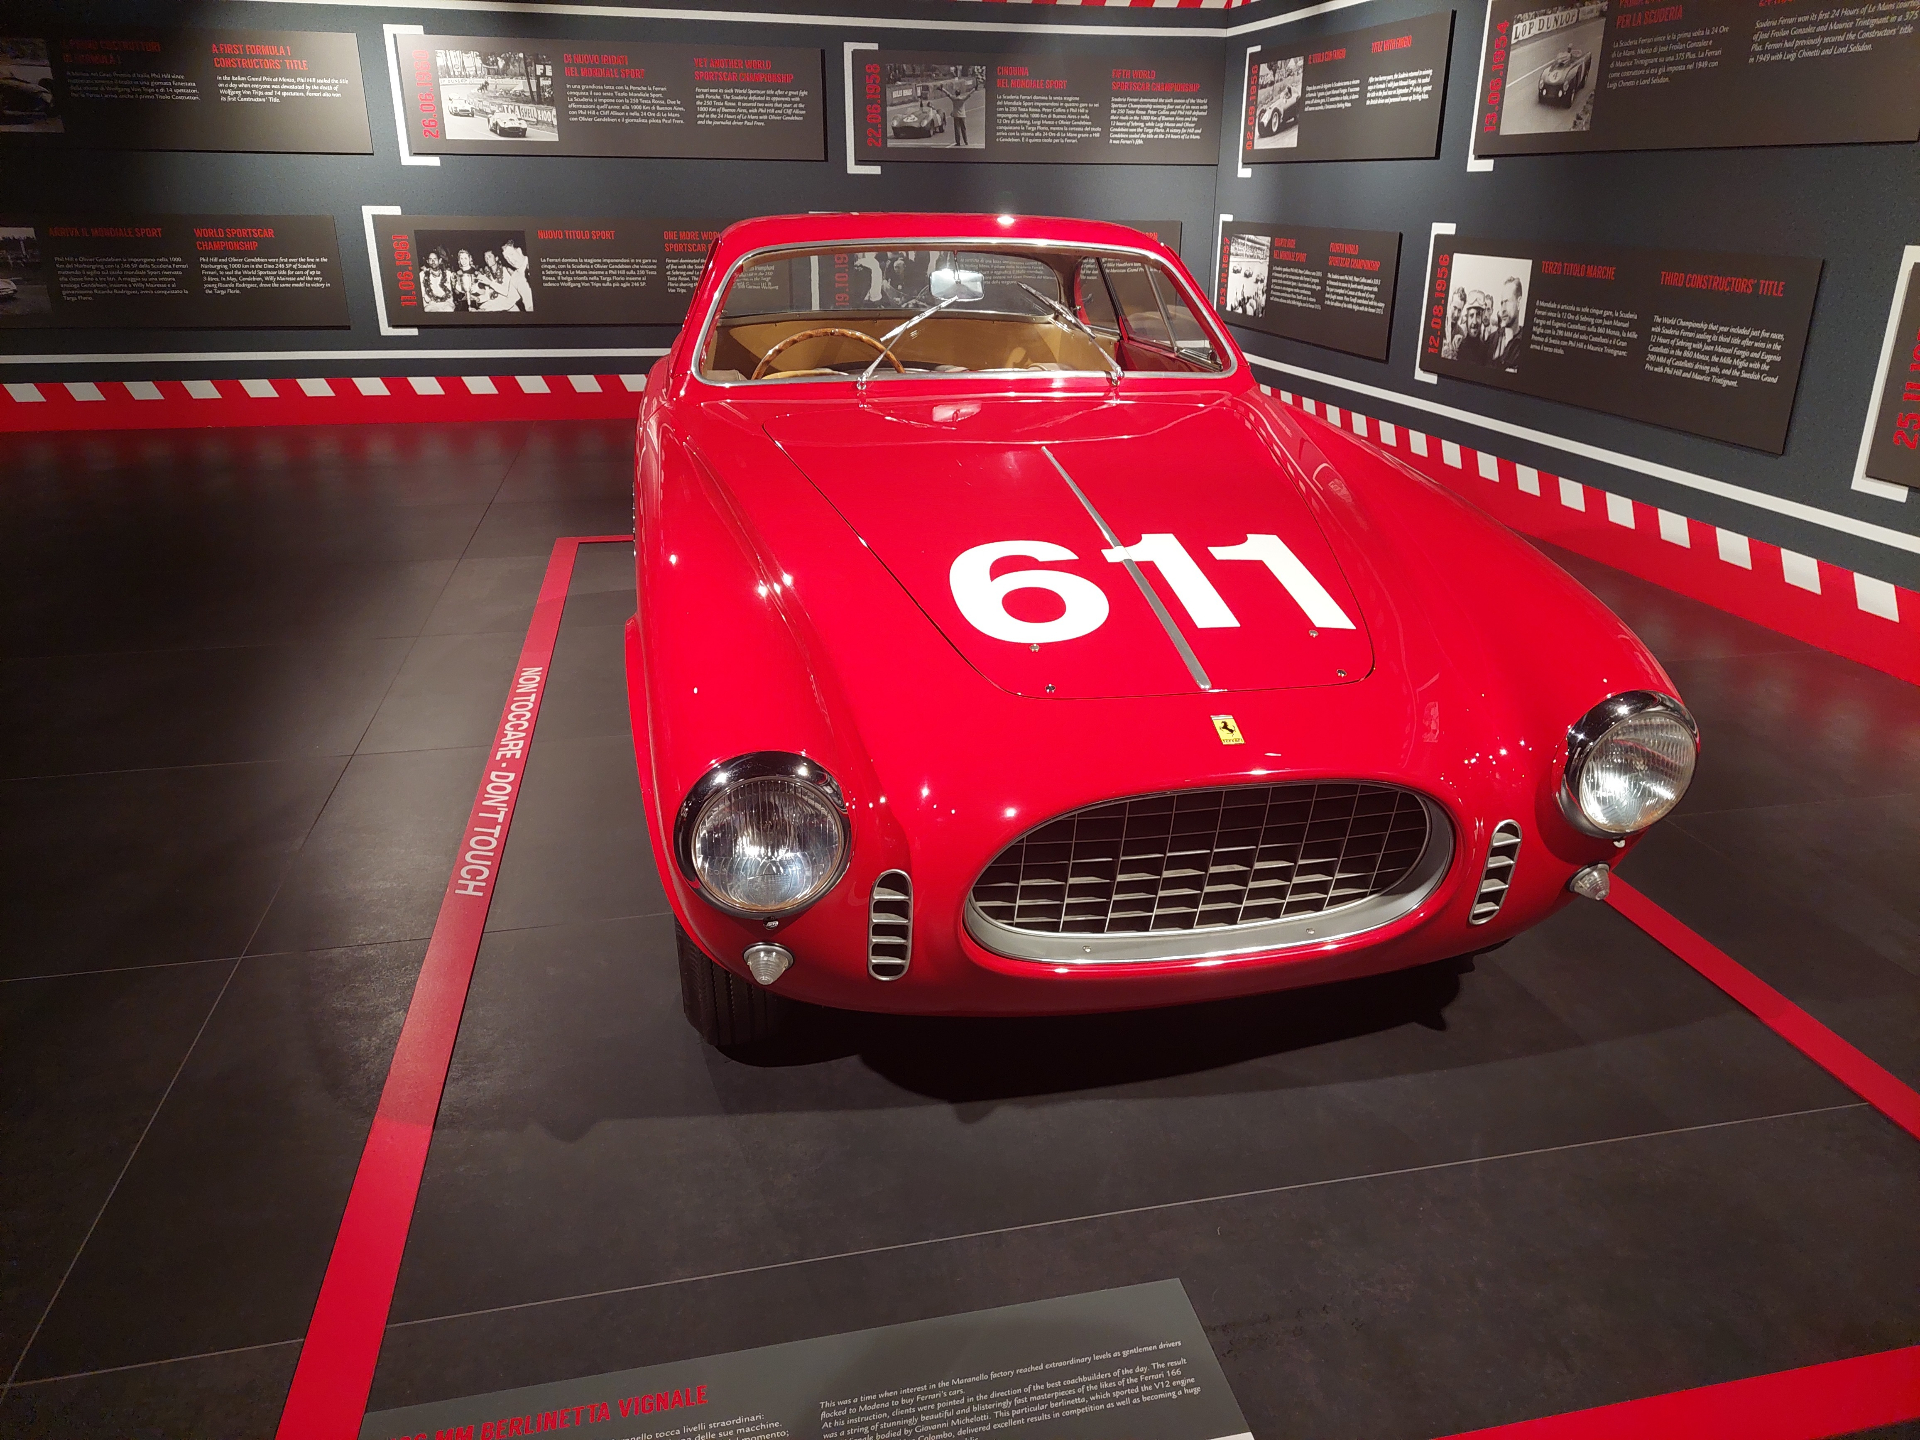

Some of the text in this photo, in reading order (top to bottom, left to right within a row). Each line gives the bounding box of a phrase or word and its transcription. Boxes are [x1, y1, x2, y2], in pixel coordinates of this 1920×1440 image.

[211, 43, 218, 53] A
[219, 43, 243, 54] FIRST
[245, 44, 285, 55] FORMULA
[284, 59, 307, 70] TITLE
[564, 67, 644, 78] NEL MONDIALE SPORT
[693, 57, 771, 69] YET ANOTHER WORLD
[412, 49, 441, 140] 26.06.1960
[1484, 20, 1510, 133] 13.06.1954
[865, 64, 882, 148] 22.06.1958
[194, 228, 274, 238] WORLD SPORTSCAR
[196, 241, 258, 250] CHAMPIONSHIP
[537, 229, 615, 239] NUOVO TITOLO SPORT
[663, 231, 677, 240] ONE
[679, 231, 699, 240] MORE
[664, 242, 706, 252] SPORTSCAR
[391, 234, 417, 307] 11.06.1961
[1660, 270, 1785, 297] THIRD CONSTRUCTORS' TITLE
[1428, 254, 1450, 354] 12.08.1956
[949, 533, 1357, 644] 611
[515, 666, 543, 693] NON
[495, 693, 536, 761] TOCCARE
[478, 771, 516, 823] DON'T
[454, 825, 502, 897] TOUCH
[820, 1400, 835, 1409] This
[860, 1394, 876, 1402] time
[878, 1390, 898, 1398] when
[899, 1384, 927, 1394] interest
[937, 1379, 949, 1388] the
[951, 1372, 988, 1385] Maranello
[989, 1369, 1014, 1380] factory
[1015, 1362, 1043, 1374] reached
[1044, 1356, 1091, 1369] extraordinary
[1092, 1351, 1112, 1360] levels
[1121, 1344, 1157, 1357] gentlemen
[1158, 1340, 1182, 1349] drivers
[822, 1421, 832, 1429] At
[833, 1418, 845, 1426] his
[846, 1411, 889, 1424] instruction,
[891, 1406, 915, 1416] clients
[917, 1403, 935, 1411] were
[936, 1396, 965, 1410] pointed
[975, 1393, 988, 1401] the
[989, 1388, 1022, 1398] direction
[1023, 1384, 1032, 1393] of
[1032, 1383, 1044, 1391] the
[1045, 1380, 1061, 1388] best
[1062, 1371, 1111, 1385] coachbuilders
[1112, 1368, 1121, 1377] of
[1121, 1367, 1133, 1375] the
[1134, 1365, 1149, 1374] day.
[1150, 1361, 1165, 1370] The
[1166, 1356, 1187, 1367] result
[481, 1402, 610, 1440] BERLINETTA
[618, 1385, 709, 1418] VIGNALE
[655, 1429, 681, 1439] tocca
[683, 1422, 706, 1434] livelli
[708, 1413, 765, 1430] straordinari:
[820, 1406, 847, 1421] flocked
[858, 1401, 889, 1412] Modena
[900, 1396, 914, 1405] buy
[916, 1390, 947, 1401] Ferrari's
[948, 1388, 965, 1396] cars.
[823, 1431, 837, 1439] was
[846, 1425, 869, 1435] string
[870, 1421, 879, 1431] of
[879, 1415, 918, 1429] stunningly
[920, 1408, 954, 1421] beautiful
[955, 1405, 970, 1415] and
[972, 1398, 1012, 1412] blisteringly
[1013, 1396, 1028, 1406] fast
[1029, 1388, 1076, 1402] masterpieces
[1077, 1384, 1085, 1394] of
[1086, 1383, 1098, 1391] the
[1099, 1381, 1116, 1389] likes
[1117, 1377, 1125, 1387] of
[1126, 1376, 1138, 1384] the
[1139, 1370, 1164, 1382] Ferrari
[1166, 1367, 1181, 1377] 166
[876, 1428, 901, 1440] bodied
[903, 1427, 913, 1436] by
[914, 1419, 948, 1432] Giovanni
[950, 1412, 991, 1426] Michelotti.
[993, 1409, 1010, 1418] This
[1011, 1402, 1048, 1418] particular
[1049, 1396, 1088, 1408] berlinetta,
[1089, 1390, 1111, 1401] which
[1112, 1385, 1139, 1398] sported
[1140, 1383, 1152, 1392] the
[1153, 1379, 1170, 1389] V12
[1171, 1376, 1195, 1387] engine
[956, 1422, 991, 1436] delivered
[992, 1417, 1025, 1429] excellent
[1026, 1412, 1051, 1423] results
[1052, 1410, 1060, 1418] in
[1061, 1403, 1104, 1417] competition
[1115, 1396, 1130, 1406] well
[1141, 1390, 1177, 1402] becoming
[1183, 1386, 1201, 1395] huge
[718, 1429, 734, 1438] sue
[736, 1421, 783, 1435] macchine.
